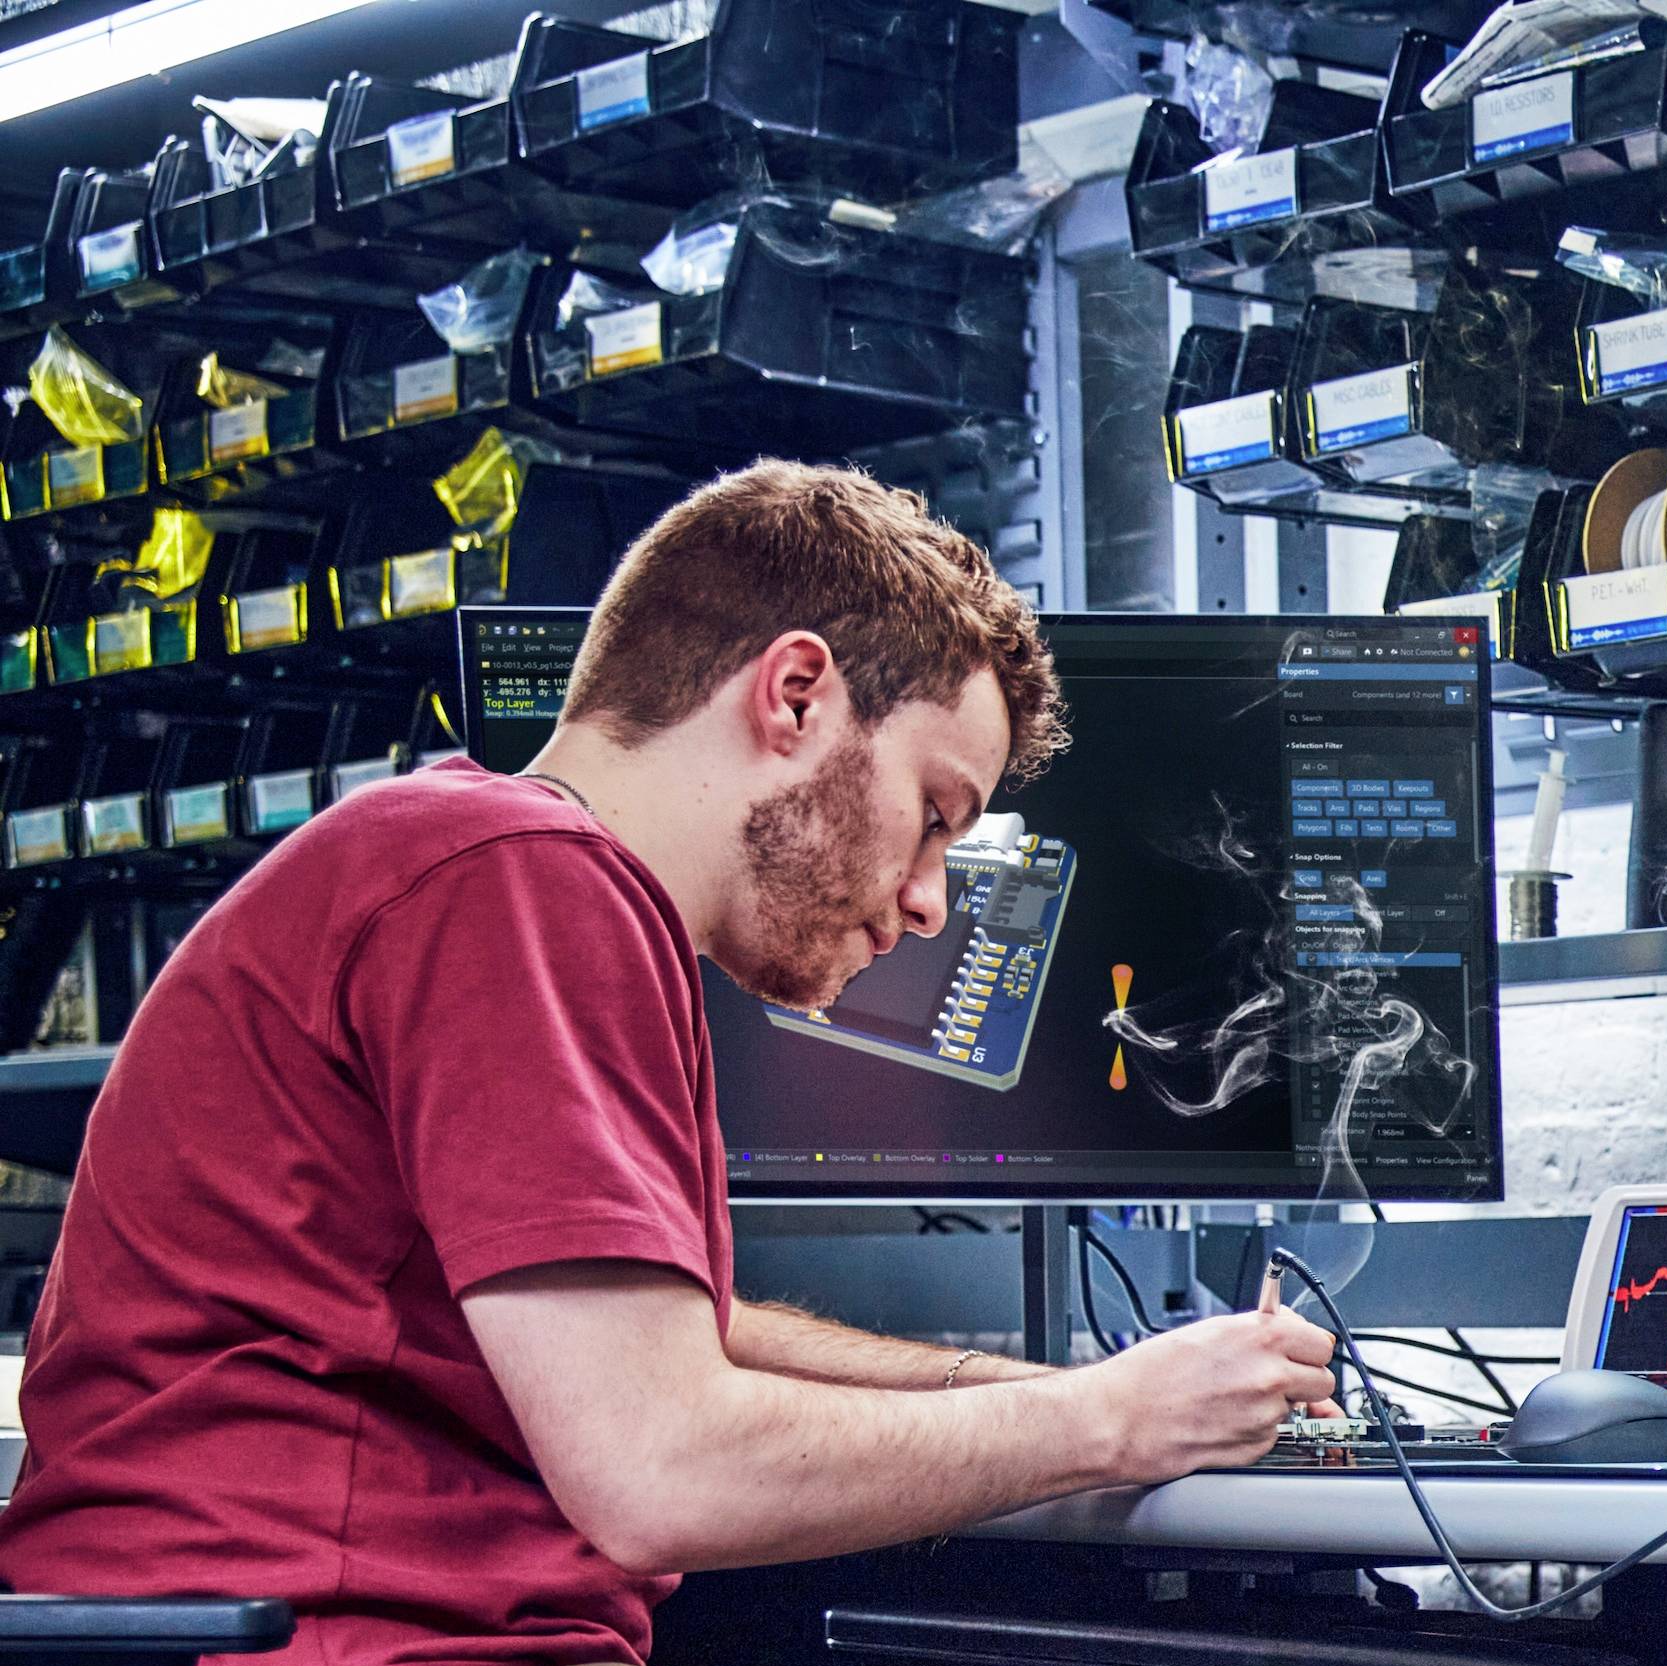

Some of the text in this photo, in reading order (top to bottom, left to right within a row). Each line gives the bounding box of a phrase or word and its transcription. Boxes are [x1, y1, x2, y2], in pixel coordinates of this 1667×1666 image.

[1602, 327, 1639, 349] SHRINK
[1641, 323, 1665, 341] TUBE
[1335, 630, 1357, 638] Search
[481, 643, 574, 653] File Edit View Project
[1332, 648, 1352, 656] Share
[1400, 648, 1453, 656] Not Connected
[493, 661, 573, 671] 10-0013_v0.5_pg1.SchD
[1280, 667, 1319, 677] Properties
[498, 678, 529, 686] 564.961
[537, 678, 551, 687] dx:
[483, 689, 492, 697] y:
[538, 688, 552, 698] dy:
[1283, 690, 1304, 698] Board
[1352, 691, 1395, 700] Components
[1412, 690, 1422, 699] 12
[484, 698, 536, 709] Top Layer
[1302, 714, 1323, 722] Search
[1291, 741, 1343, 750] Selection Filter
[1302, 763, 1310, 771] All
[1317, 763, 1328, 771] On
[1297, 784, 1339, 794] Components
[1363, 784, 1384, 792] Bodies
[1398, 784, 1429, 794] Keepouts
[1297, 804, 1317, 812] Tracks
[1358, 804, 1375, 812] Pads
[1415, 805, 1441, 814] Regions
[1298, 824, 1327, 833] Polygons
[1396, 824, 1418, 832] Rooms
[1432, 824, 1452, 832] Other
[1294, 854, 1342, 862] Snap Options
[1294, 893, 1327, 902] Snapping
[1387, 909, 1404, 917] Layer
[1435, 909, 1446, 917] Off
[1295, 926, 1365, 935] Objects for snapping
[791, 1154, 808, 1163] Layer
[828, 1154, 866, 1163] Top Overlay
[885, 1154, 936, 1163] Bottom Overlay
[955, 1155, 967, 1163] Top
[1375, 1156, 1408, 1165] Properties
[1416, 1156, 1431, 1164] View
[1467, 1174, 1487, 1182] Panels
